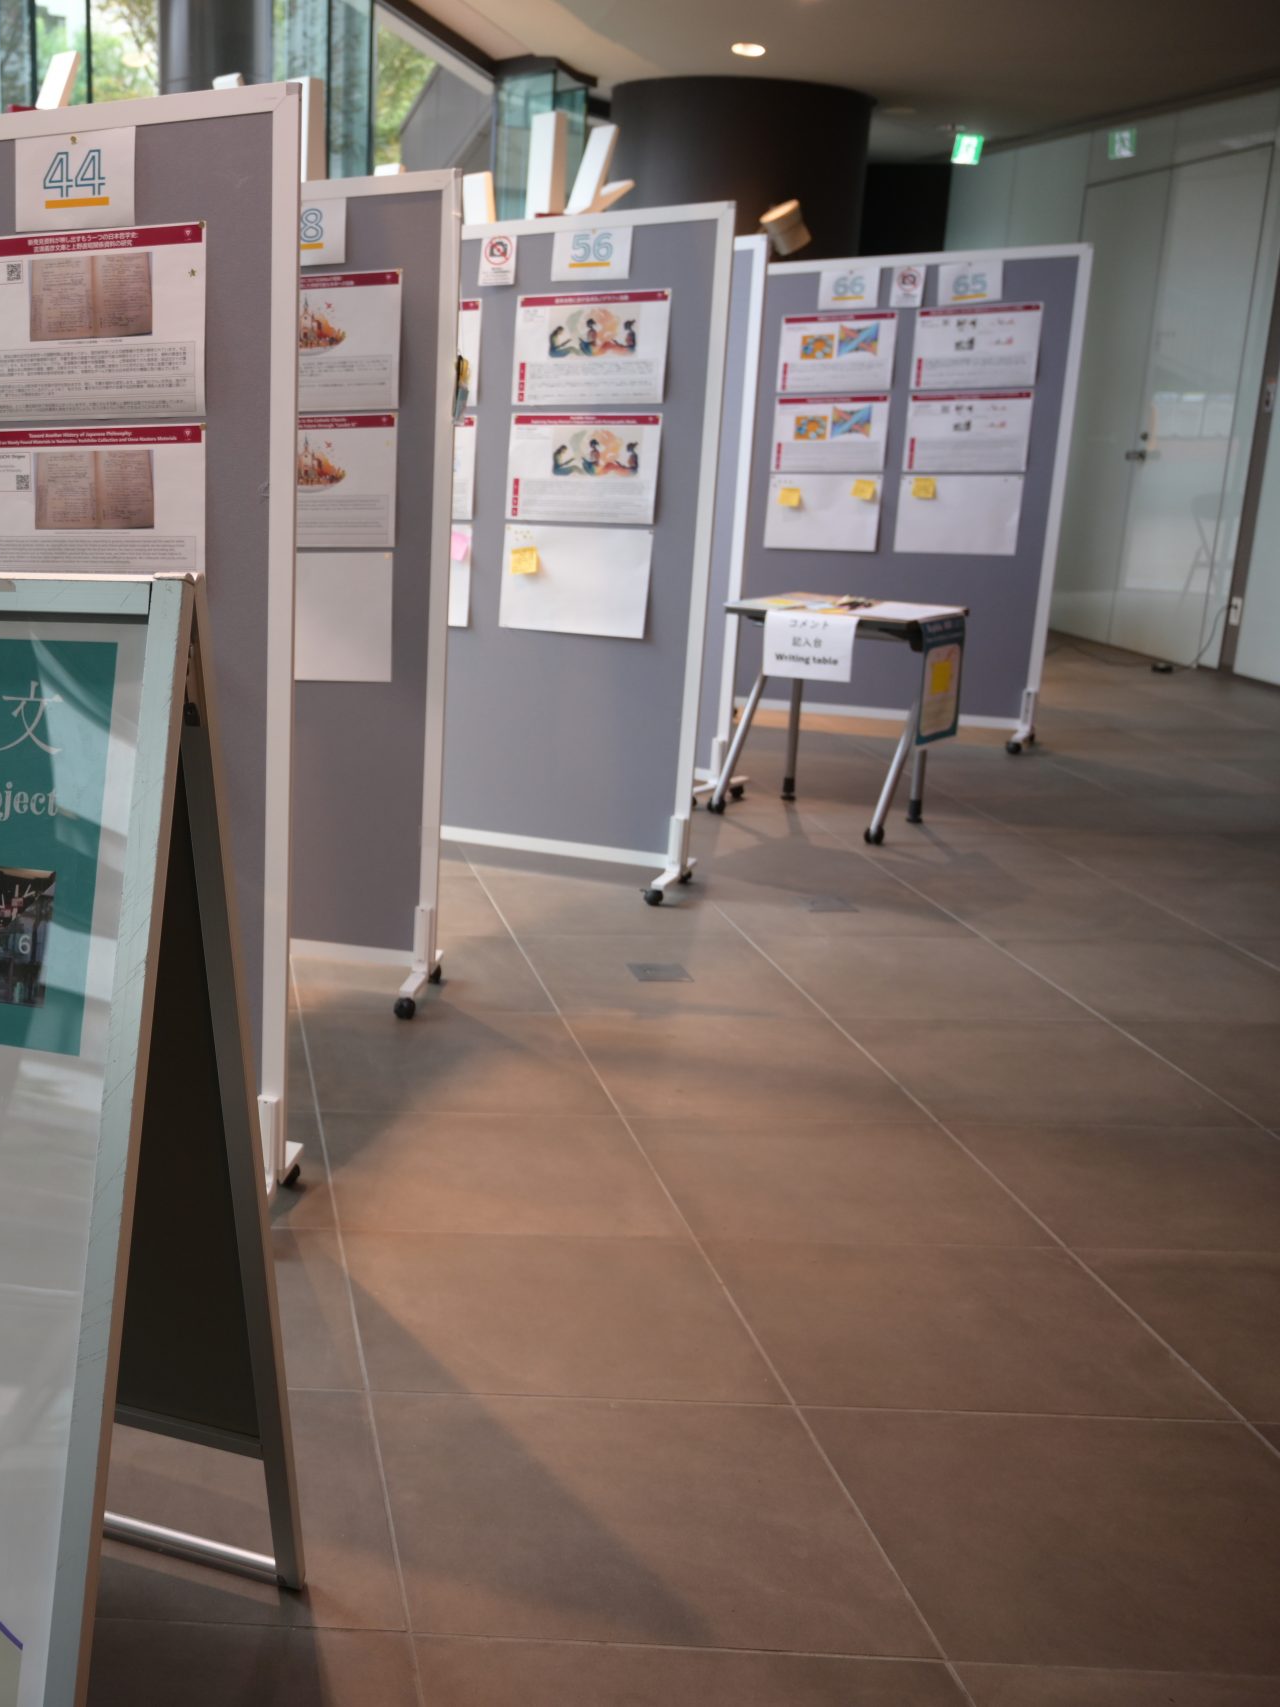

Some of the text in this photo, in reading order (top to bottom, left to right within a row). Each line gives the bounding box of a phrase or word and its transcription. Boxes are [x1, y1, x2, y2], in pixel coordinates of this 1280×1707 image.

[43, 149, 106, 198] 44
[570, 232, 614, 262] 56
[833, 276, 865, 296] 66
[952, 273, 988, 295] 65
[788, 618, 830, 630] コメント
[775, 652, 839, 666] Writing table
[18, 935, 31, 954] 6
